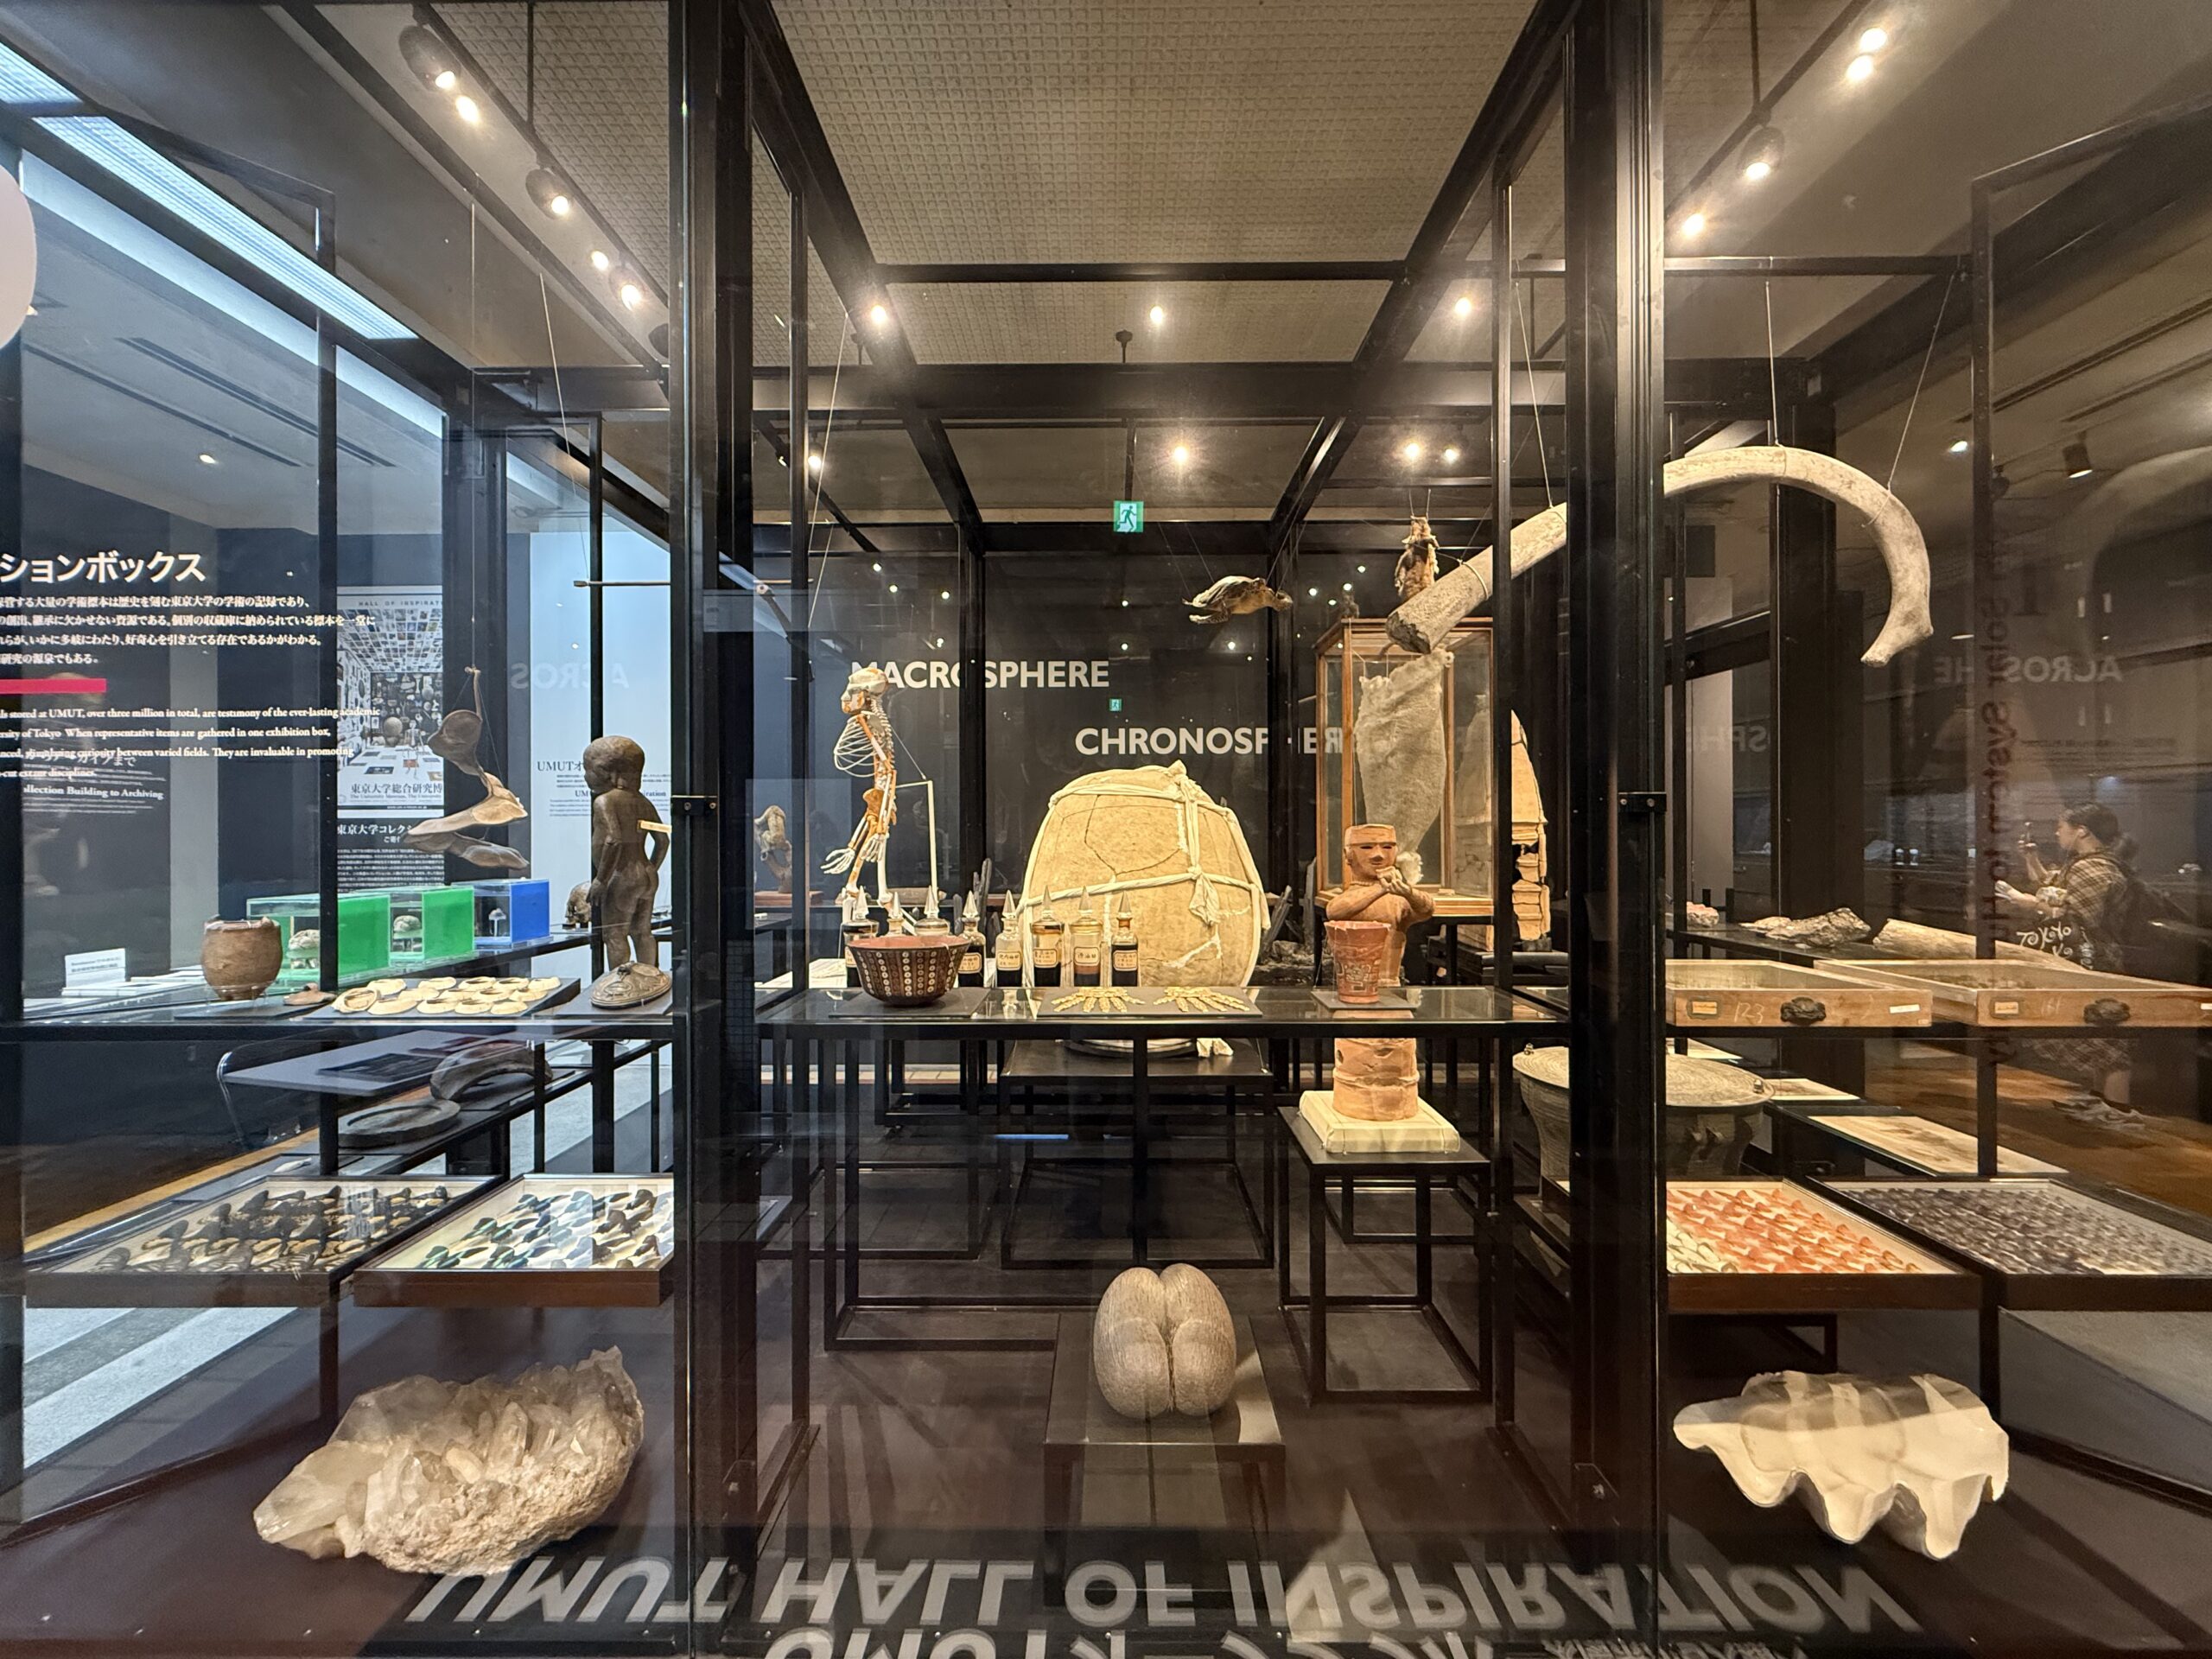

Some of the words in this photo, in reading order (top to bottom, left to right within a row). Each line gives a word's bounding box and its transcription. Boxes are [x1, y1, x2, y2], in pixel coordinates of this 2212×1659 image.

[0, 550, 207, 583] ションボックス
[0, 634, 321, 646] らが、いかに多岐にわたり、好奇心を引き立てる存在であるかがわかる。
[10, 709, 36, 718] stored
[48, 709, 86, 720] UMUT,
[107, 709, 130, 717] three
[131, 708, 164, 717] million
[166, 708, 175, 717] in
[177, 708, 200, 719] total,
[218, 709, 260, 720] testimony
[262, 707, 273, 717] of
[273, 708, 288, 717] the
[289, 707, 339, 720] ever-lasting
[340, 706, 380, 716] academic
[22, 728, 33, 738] of
[65, 728, 92, 738] When
[94, 728, 154, 740] representative
[156, 728, 180, 737] items
[197, 728, 235, 741] gathered
[237, 728, 246, 737] in
[265, 727, 310, 737] exhibition
[117, 747, 152, 757] between
[154, 747, 182, 757] varied
[183, 747, 209, 757] fields.
[213, 747, 234, 760] They
[251, 747, 295, 757] invaluable
[296, 747, 306, 756] in
[307, 747, 354, 760] promoting
[67, 785, 109, 798] Building
[110, 788, 120, 797] to
[121, 788, 164, 800] Archiving
[351, 783, 442, 794] 東京大学総合研究博
